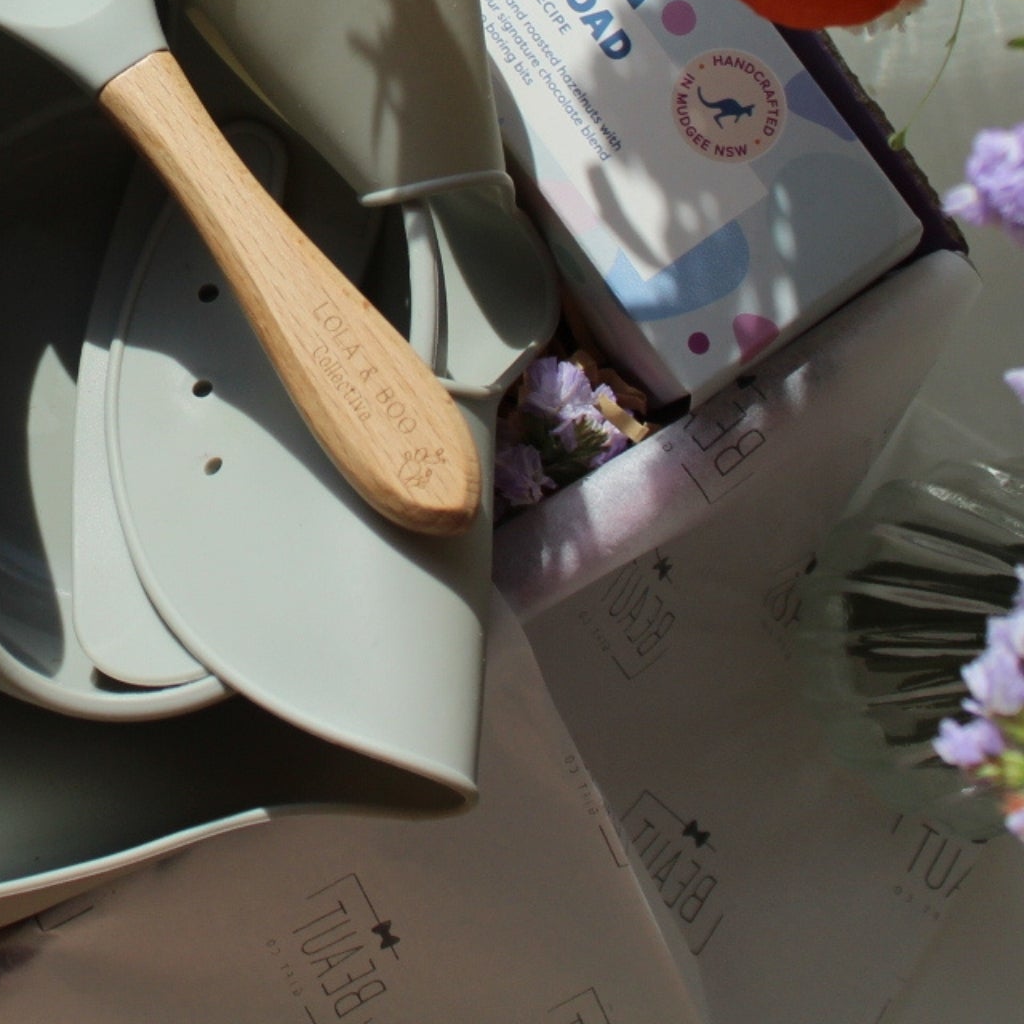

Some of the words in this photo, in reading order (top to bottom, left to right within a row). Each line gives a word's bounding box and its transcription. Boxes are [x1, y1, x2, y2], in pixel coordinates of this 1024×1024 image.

[485, 21, 517, 64] boring
[513, 60, 533, 87] bits
[497, 12, 541, 69] signature
[538, 68, 584, 127] chocolate
[580, 125, 612, 162] blend
[524, 19, 561, 67] roasted
[558, 65, 603, 124] hazelnuts
[599, 121, 622, 153] with
[680, 72, 695, 89] IN
[676, 92, 711, 151] MUDGEE
[713, 55, 779, 137] HANDCRAFTED
[714, 144, 747, 157] NSW
[313, 302, 362, 360] LOLA
[359, 365, 378, 383] &
[376, 386, 417, 434] BOO
[313, 344, 372, 422] Collective
